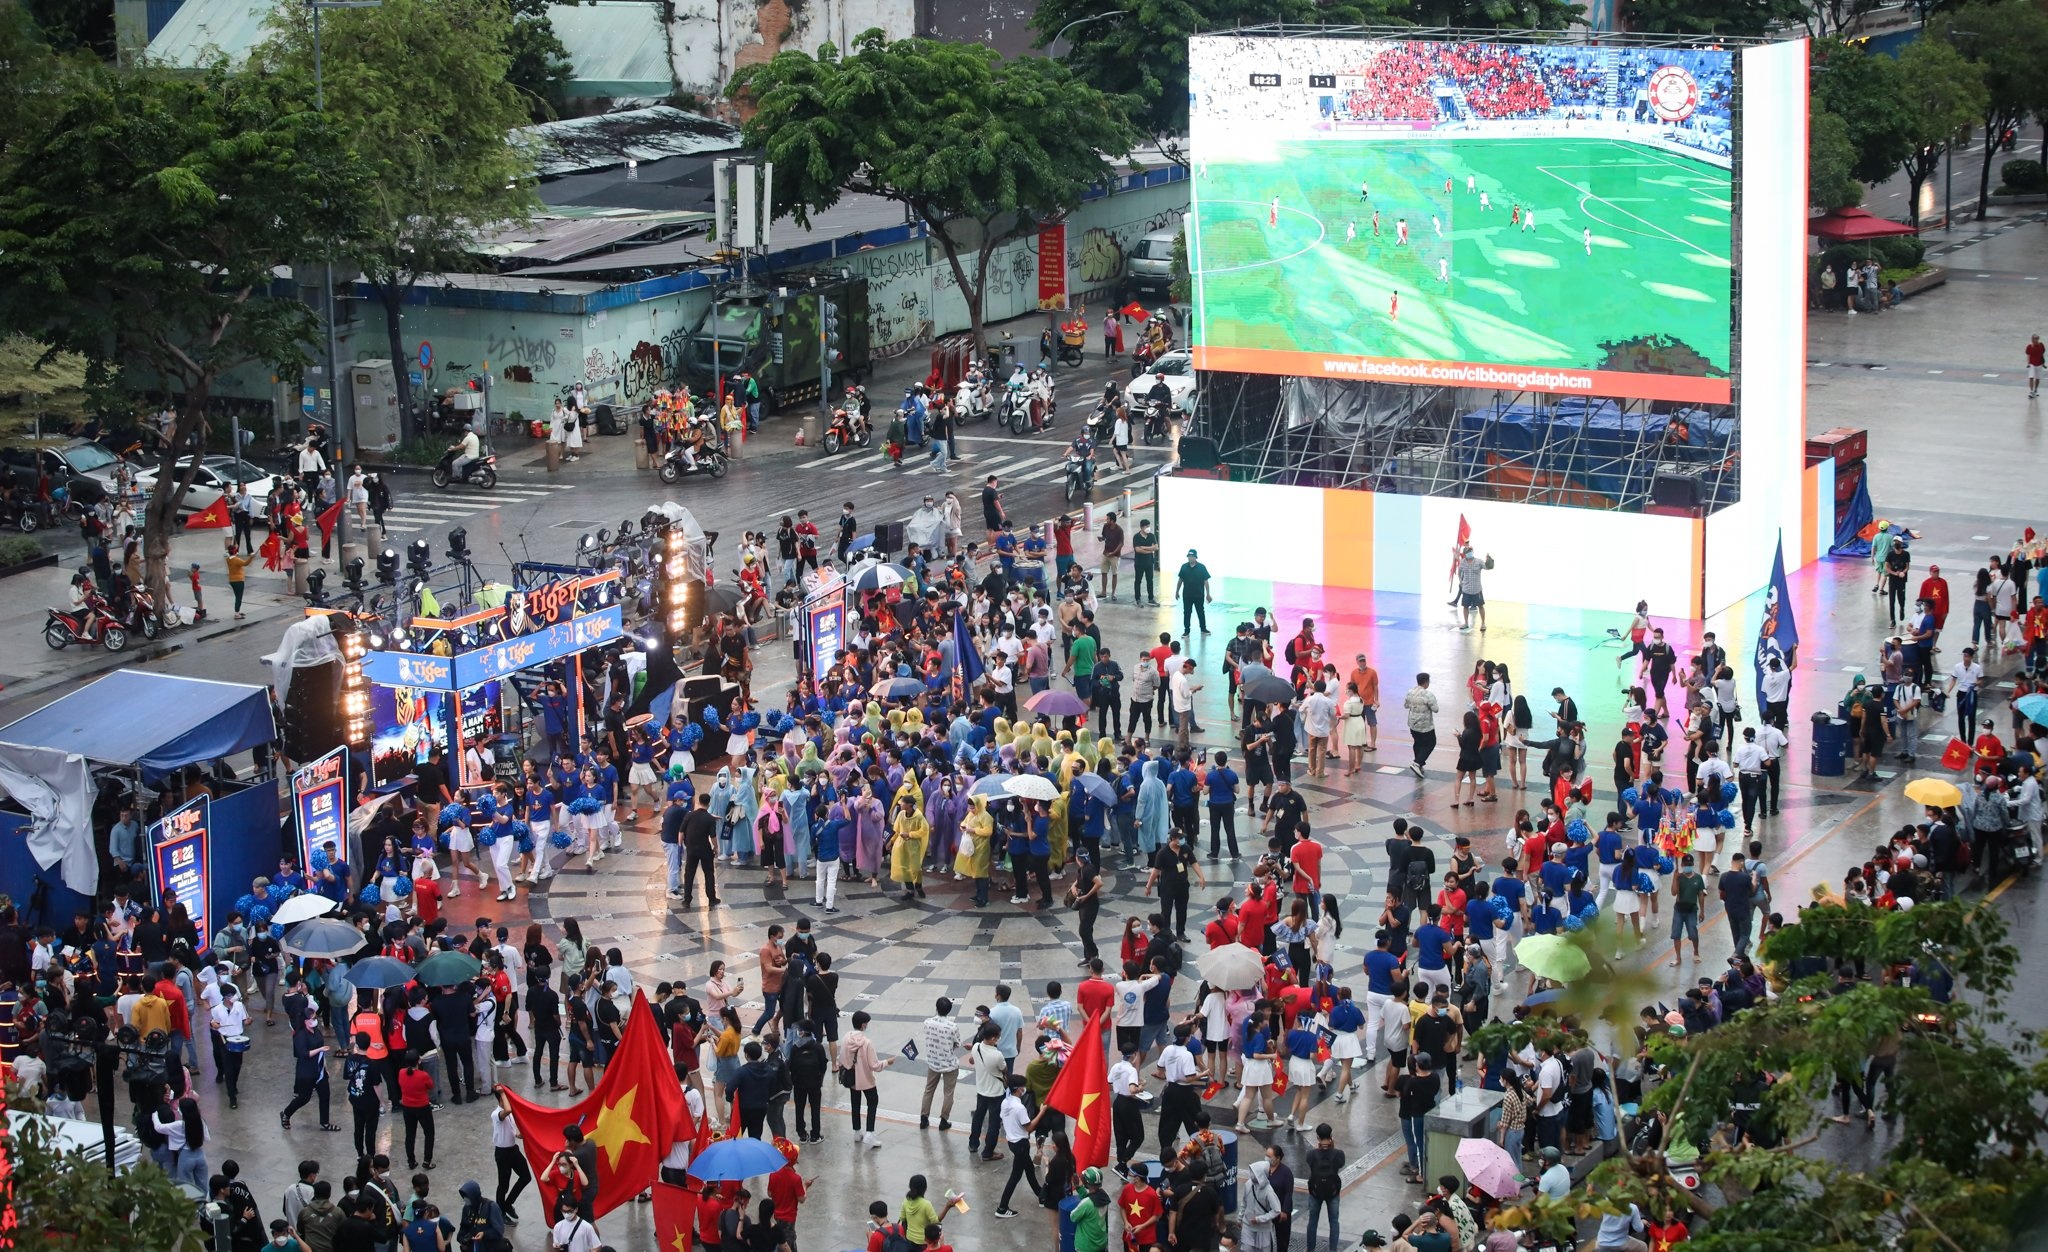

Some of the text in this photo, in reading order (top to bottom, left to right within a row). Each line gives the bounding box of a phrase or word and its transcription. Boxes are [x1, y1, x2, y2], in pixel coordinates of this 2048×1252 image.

[1344, 79, 1356, 87] VIE
[1324, 359, 1591, 390] www.facebook.com/clbbongdatphcm
[528, 580, 577, 622] Tiger
[585, 616, 611, 638] Tiger
[507, 640, 535, 664] Tiger
[412, 658, 448, 683] Tiger
[468, 714, 484, 728] NAM
[476, 724, 484, 734] 31
[311, 759, 338, 780] Tiger
[172, 809, 201, 832] Tiger
